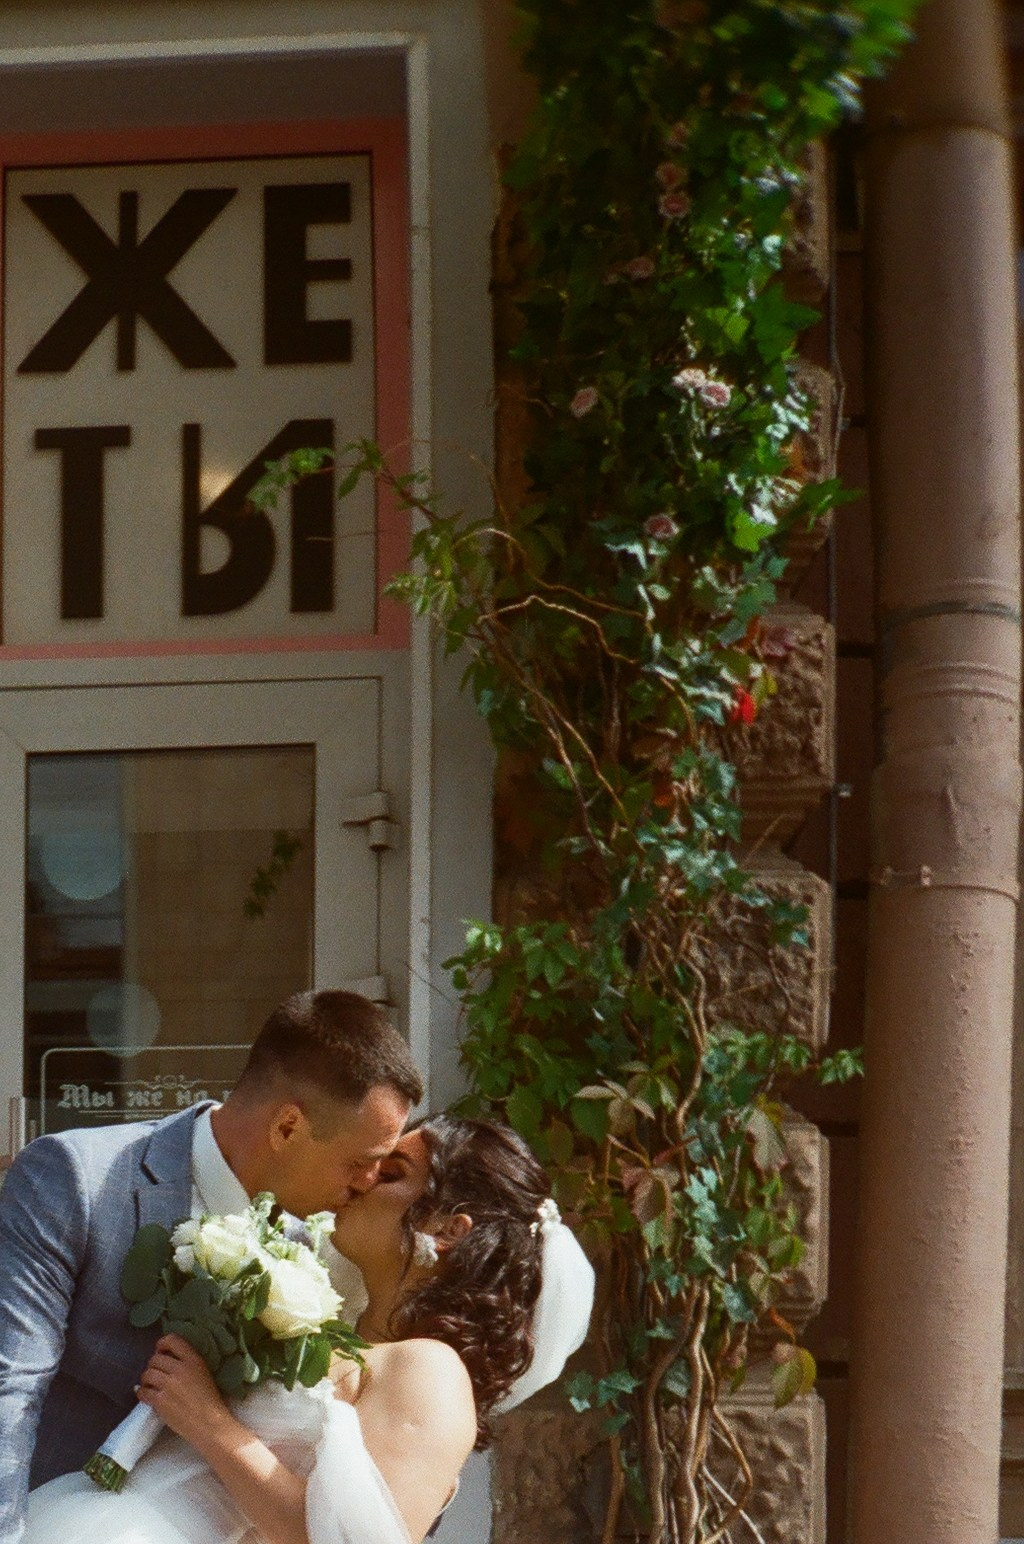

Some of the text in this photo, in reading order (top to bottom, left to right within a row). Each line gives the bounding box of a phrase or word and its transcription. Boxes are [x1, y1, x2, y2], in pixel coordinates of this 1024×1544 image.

[16, 182, 353, 375] ЖЕ
[34, 419, 337, 620] ТЫ
[57, 1083, 115, 1109] Мы
[126, 1089, 164, 1107] же
